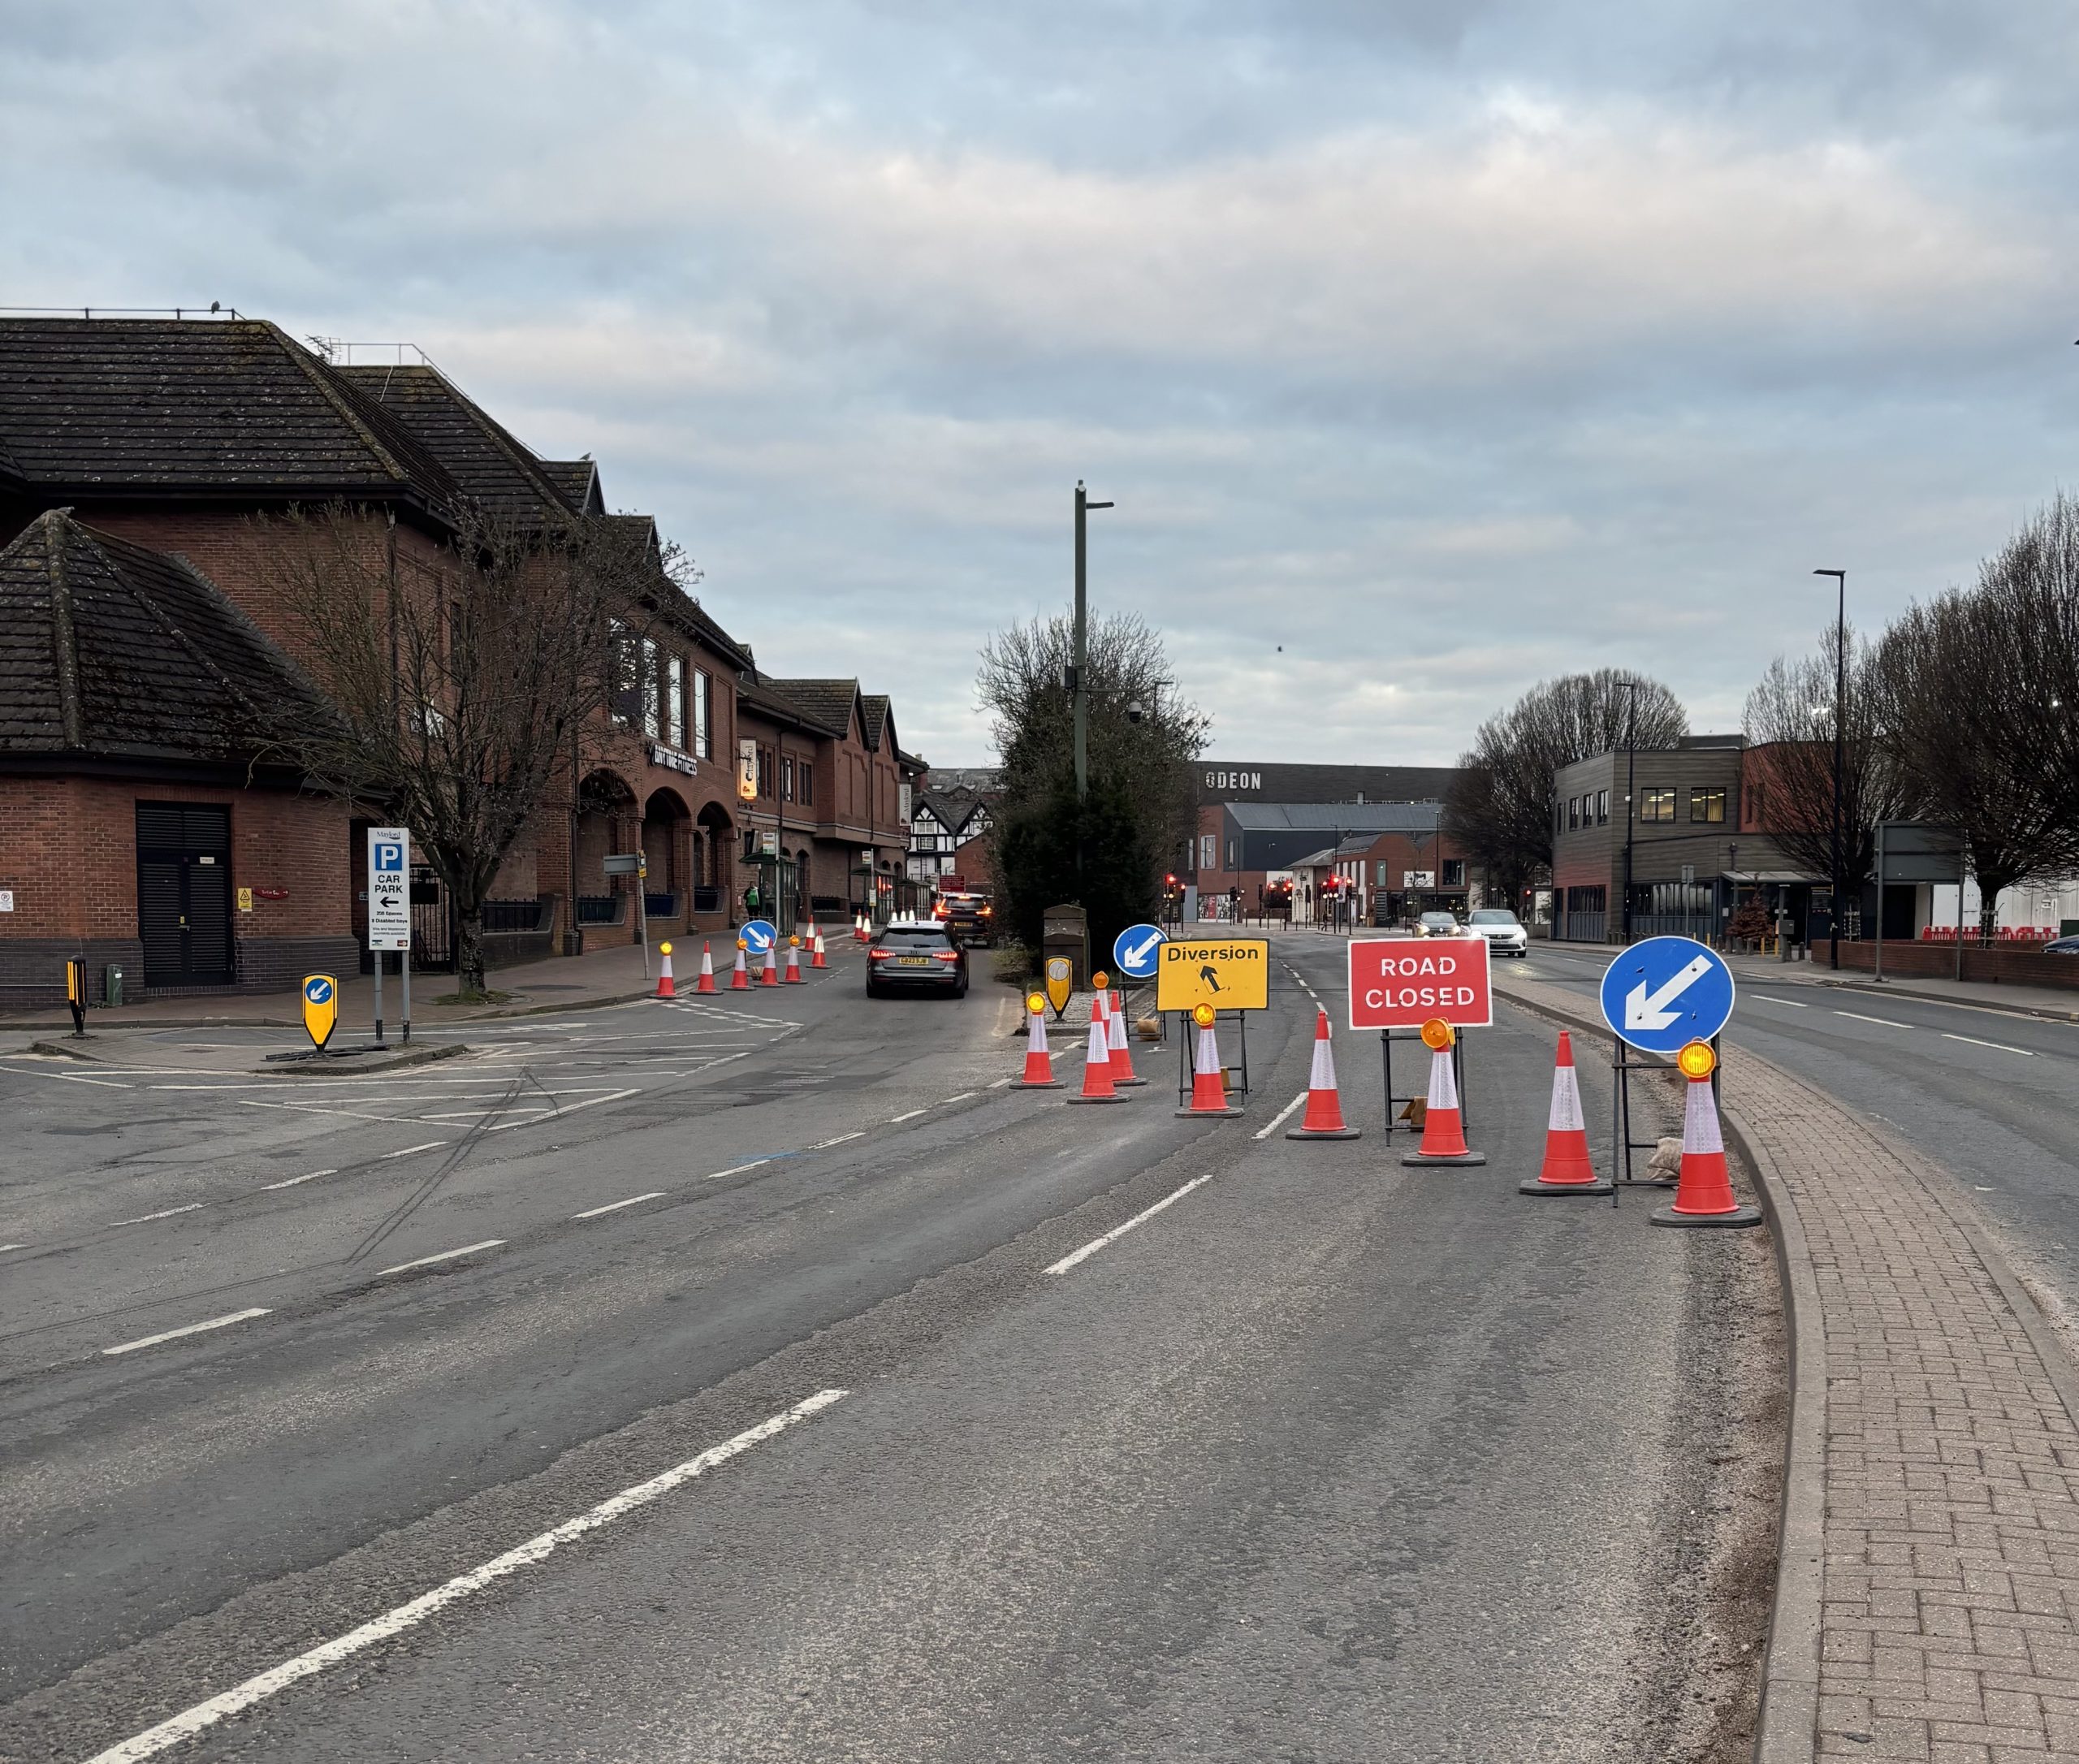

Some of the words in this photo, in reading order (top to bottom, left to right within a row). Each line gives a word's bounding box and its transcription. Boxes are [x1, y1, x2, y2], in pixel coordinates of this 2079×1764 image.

[1205, 772, 1261, 789] ODEON
[377, 831, 400, 839] Maylord
[381, 846, 399, 869] P
[378, 875, 400, 884] CAR
[374, 884, 403, 894] PARK
[1168, 945, 1259, 962] Diversion
[1381, 957, 1456, 976] ROAD
[1365, 987, 1475, 1008] CLOSED
